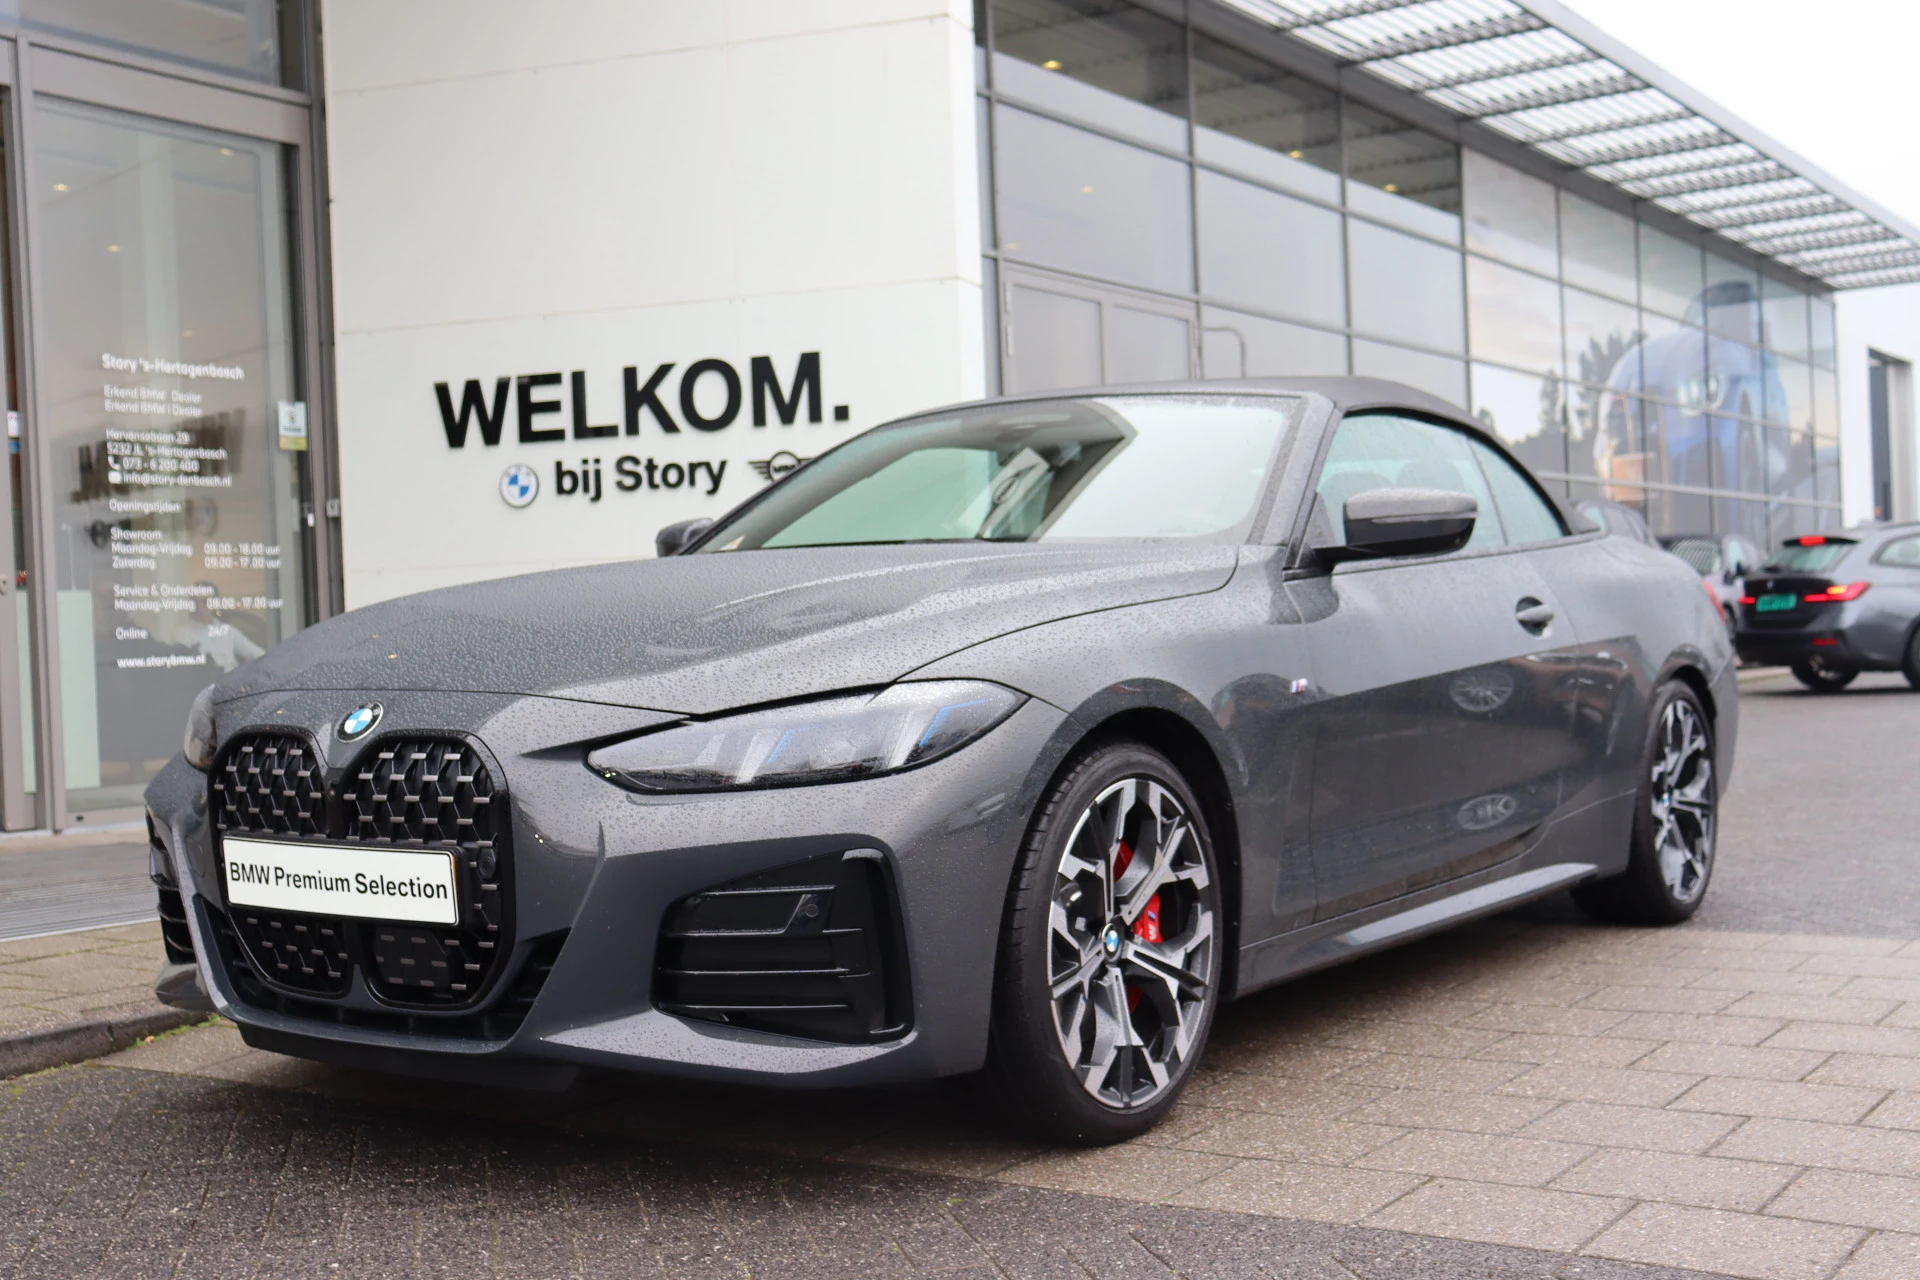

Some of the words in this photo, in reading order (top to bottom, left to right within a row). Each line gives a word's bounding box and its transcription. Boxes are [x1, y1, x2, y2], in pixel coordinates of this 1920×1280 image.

[102, 353, 137, 373] Story
[139, 357, 245, 379] 's-Hertogenbosch
[103, 384, 137, 399] Erkend
[139, 387, 165, 400] BMW
[171, 390, 202, 403] Dealer
[433, 351, 851, 449] WELKOM.
[104, 399, 138, 413] Erkend
[140, 401, 165, 415] BMW
[172, 404, 203, 417] Dealer
[175, 430, 190, 445] 29
[106, 441, 132, 455] 5232
[145, 444, 228, 460] 's-Hertogenbosch
[122, 456, 143, 470] 073
[158, 458, 179, 472] 200
[179, 459, 200, 472] 400
[123, 471, 233, 488] info@story-denbosch.nl
[555, 459, 602, 502] bij
[615, 455, 727, 495] Story
[109, 498, 182, 515] Openingstijden
[110, 527, 162, 540] Showroom
[111, 542, 193, 556] Maandag-Vrijdag
[204, 542, 231, 555] 09.00
[239, 542, 264, 555] 18.00
[112, 556, 157, 571] Zaterdag
[204, 556, 233, 569] 09.00
[239, 556, 265, 569] 17.00
[266, 560, 281, 568] uur
[113, 584, 148, 598] Service
[150, 584, 159, 596] &
[160, 584, 214, 597] Onderdelen
[114, 598, 197, 613] Maandag-Vrijdag
[207, 597, 235, 610] 08.00
[242, 597, 267, 610] 17.00
[268, 600, 284, 609] uur
[116, 627, 148, 640] Online
[207, 624, 231, 637] 24/7
[117, 655, 207, 669] www.storybmw.nl
[230, 861, 270, 885] BMW
[274, 866, 351, 893] Premium
[355, 872, 448, 900] Selection
